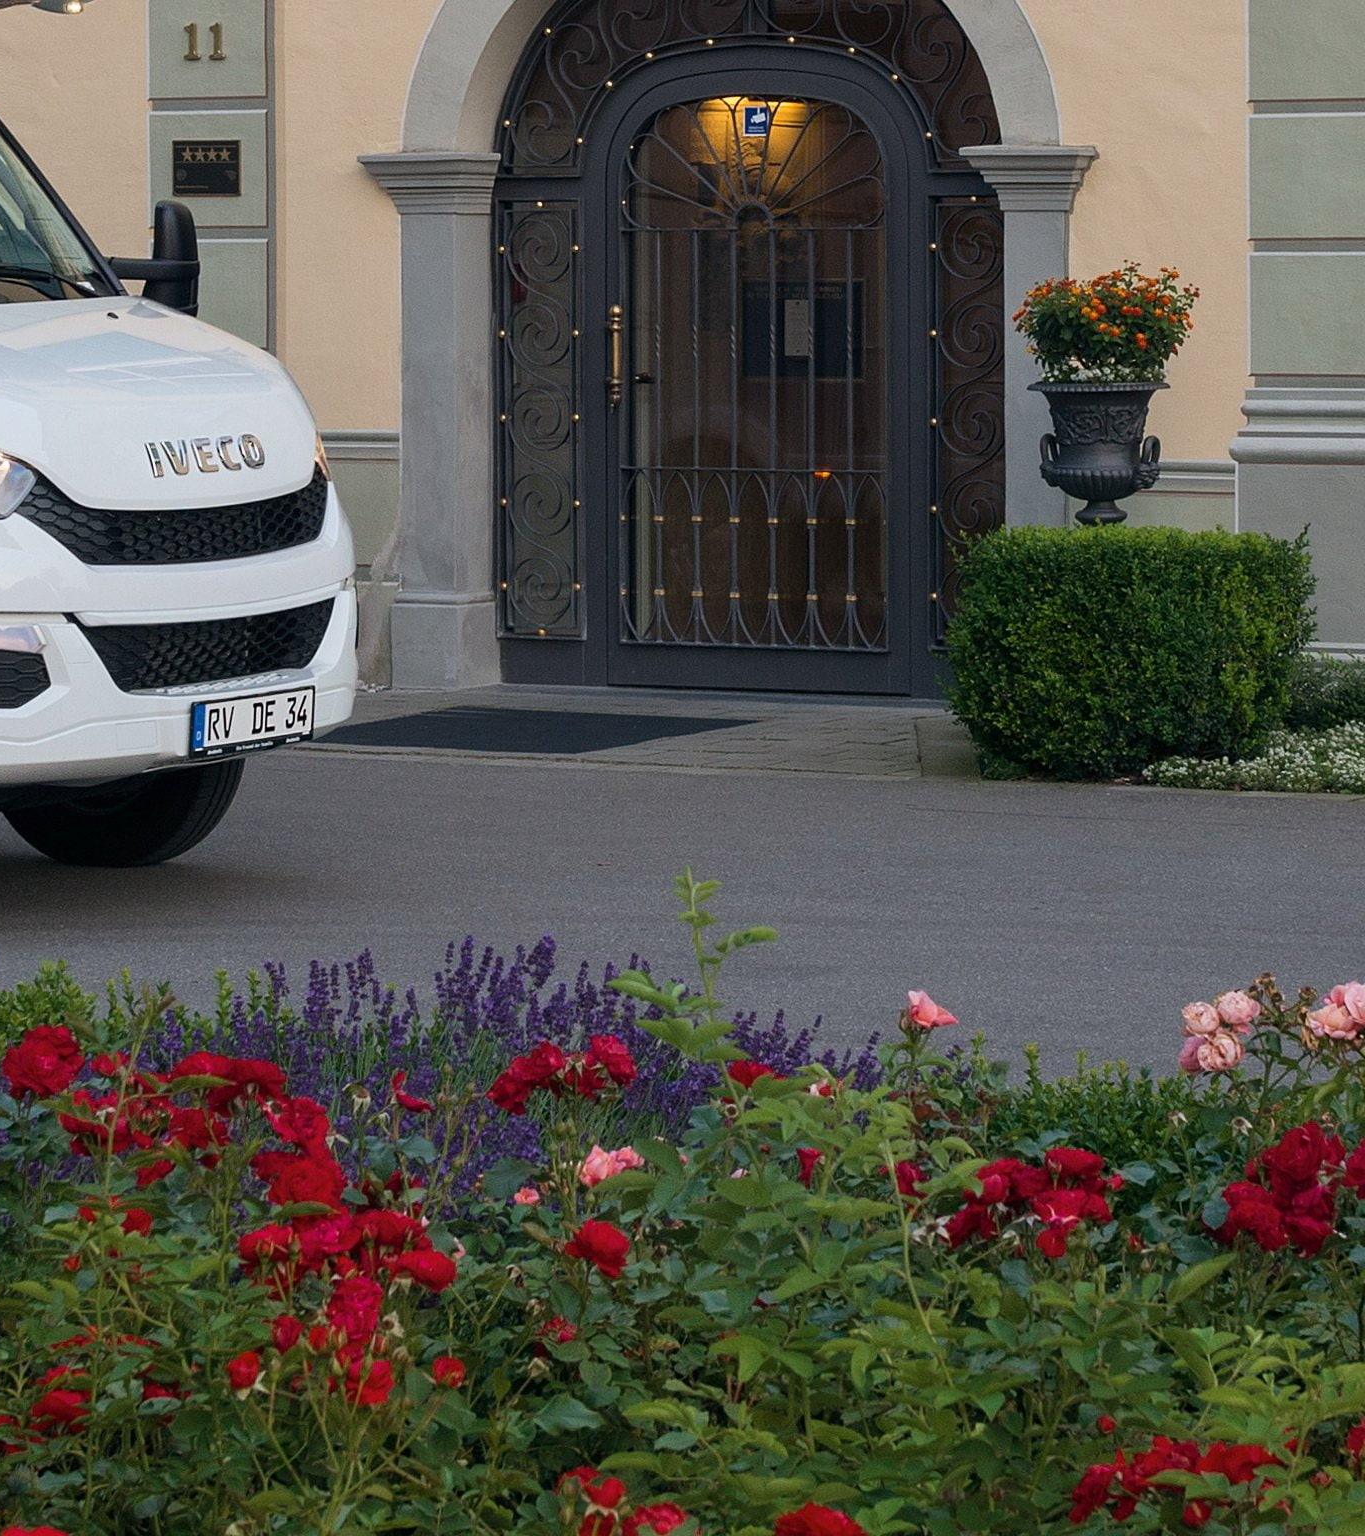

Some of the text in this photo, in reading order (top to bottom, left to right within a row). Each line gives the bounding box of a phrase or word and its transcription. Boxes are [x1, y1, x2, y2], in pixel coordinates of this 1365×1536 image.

[183, 21, 227, 61] 11
[144, 433, 266, 478] IVECO
[207, 705, 235, 741] RV
[251, 700, 276, 735] DE
[285, 695, 308, 729] 34
